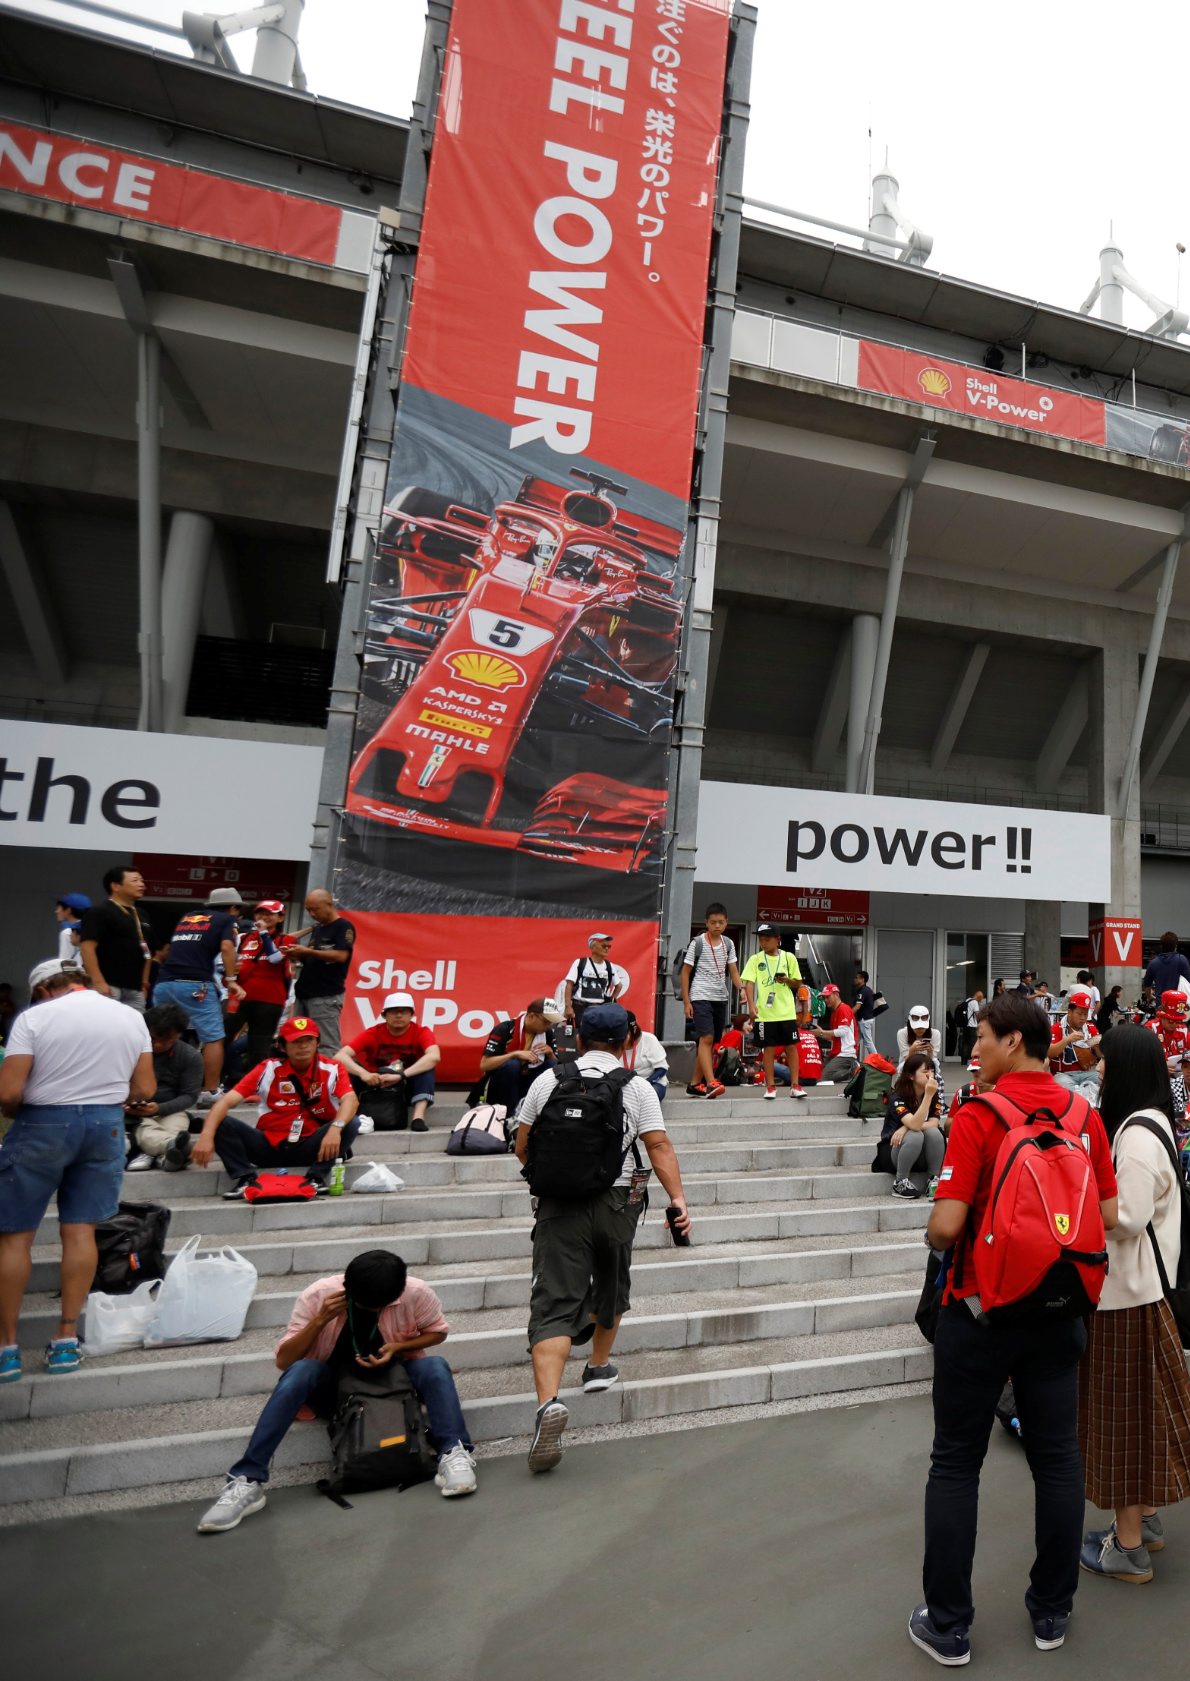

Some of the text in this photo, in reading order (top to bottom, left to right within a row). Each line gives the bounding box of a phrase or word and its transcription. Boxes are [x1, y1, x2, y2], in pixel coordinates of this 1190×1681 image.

[509, 0, 635, 455] EEL POWER
[966, 377, 998, 395] Shell
[966, 389, 1047, 422] V-Power
[488, 619, 525, 649] 5
[429, 686, 482, 706] AMD
[405, 724, 491, 755] MAHLE
[786, 820, 1032, 874] power!!
[1112, 932, 1134, 961] V
[355, 959, 457, 991] Shell
